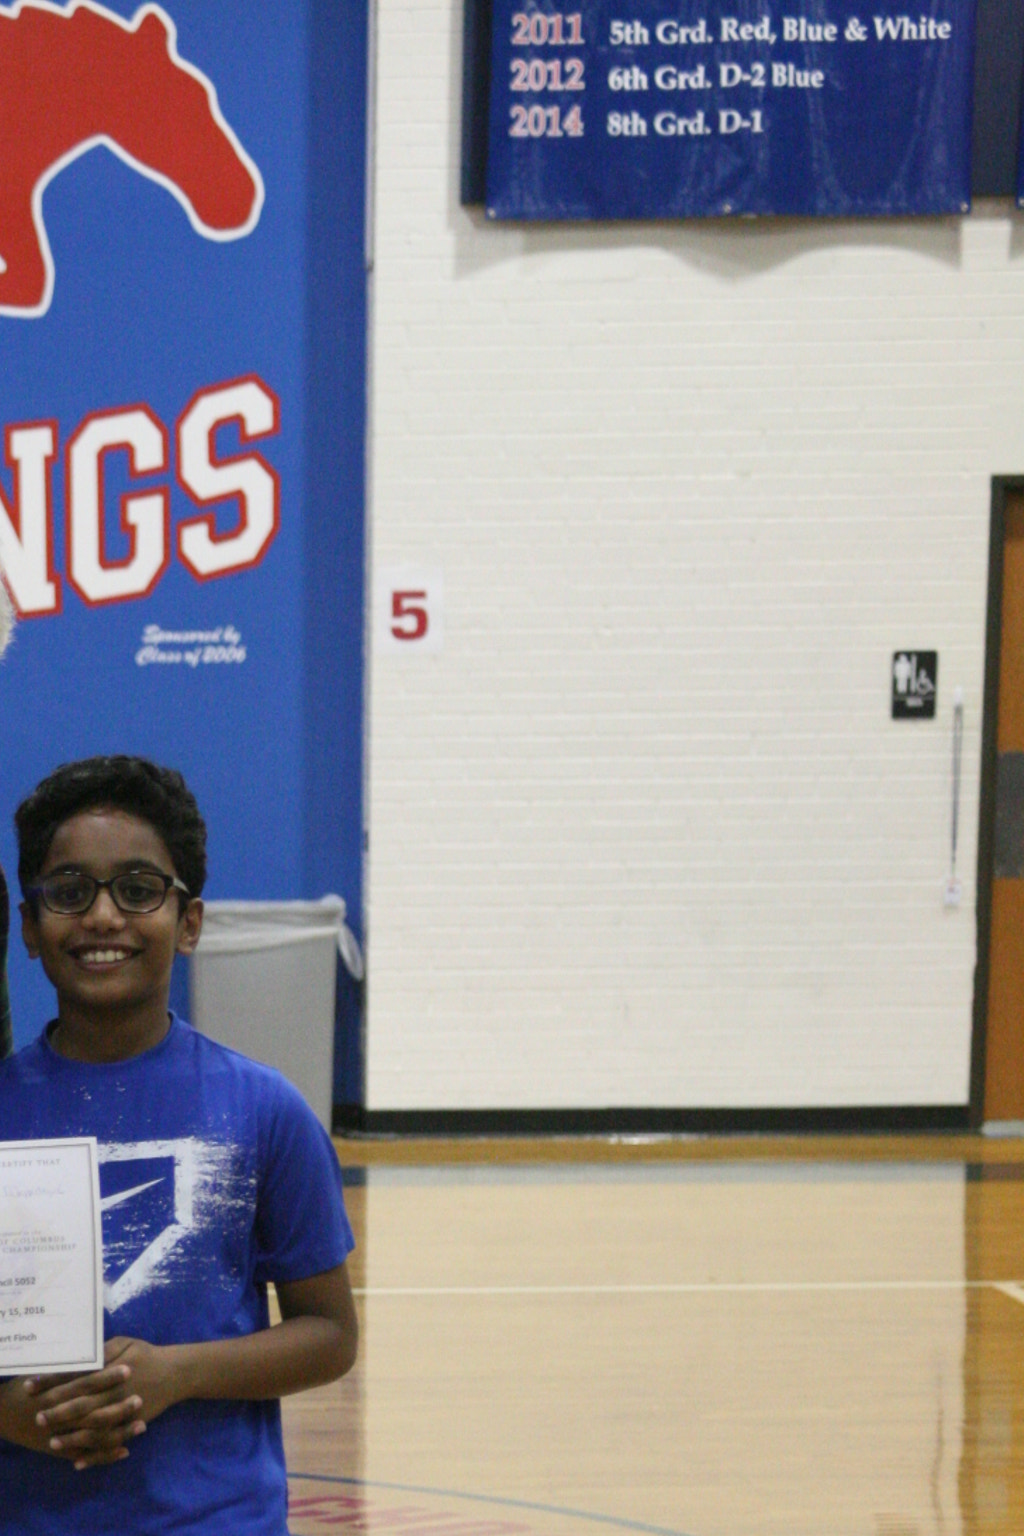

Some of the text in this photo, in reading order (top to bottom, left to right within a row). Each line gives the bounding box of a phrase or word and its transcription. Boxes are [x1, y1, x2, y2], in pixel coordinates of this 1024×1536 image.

[511, 12, 952, 46] 2011 5th Grd. Red, Blue & White
[509, 58, 825, 92] 2012 6th Grd. D-2 Blue
[508, 104, 764, 138] 2014 8th Grd. D-1
[390, 589, 429, 642] 5
[141, 624, 241, 646] Sponsored by
[135, 645, 182, 666] Class
[9, 1308, 21, 1317] 15,
[24, 1306, 45, 1315] 2016
[14, 1333, 37, 1342] Finch
